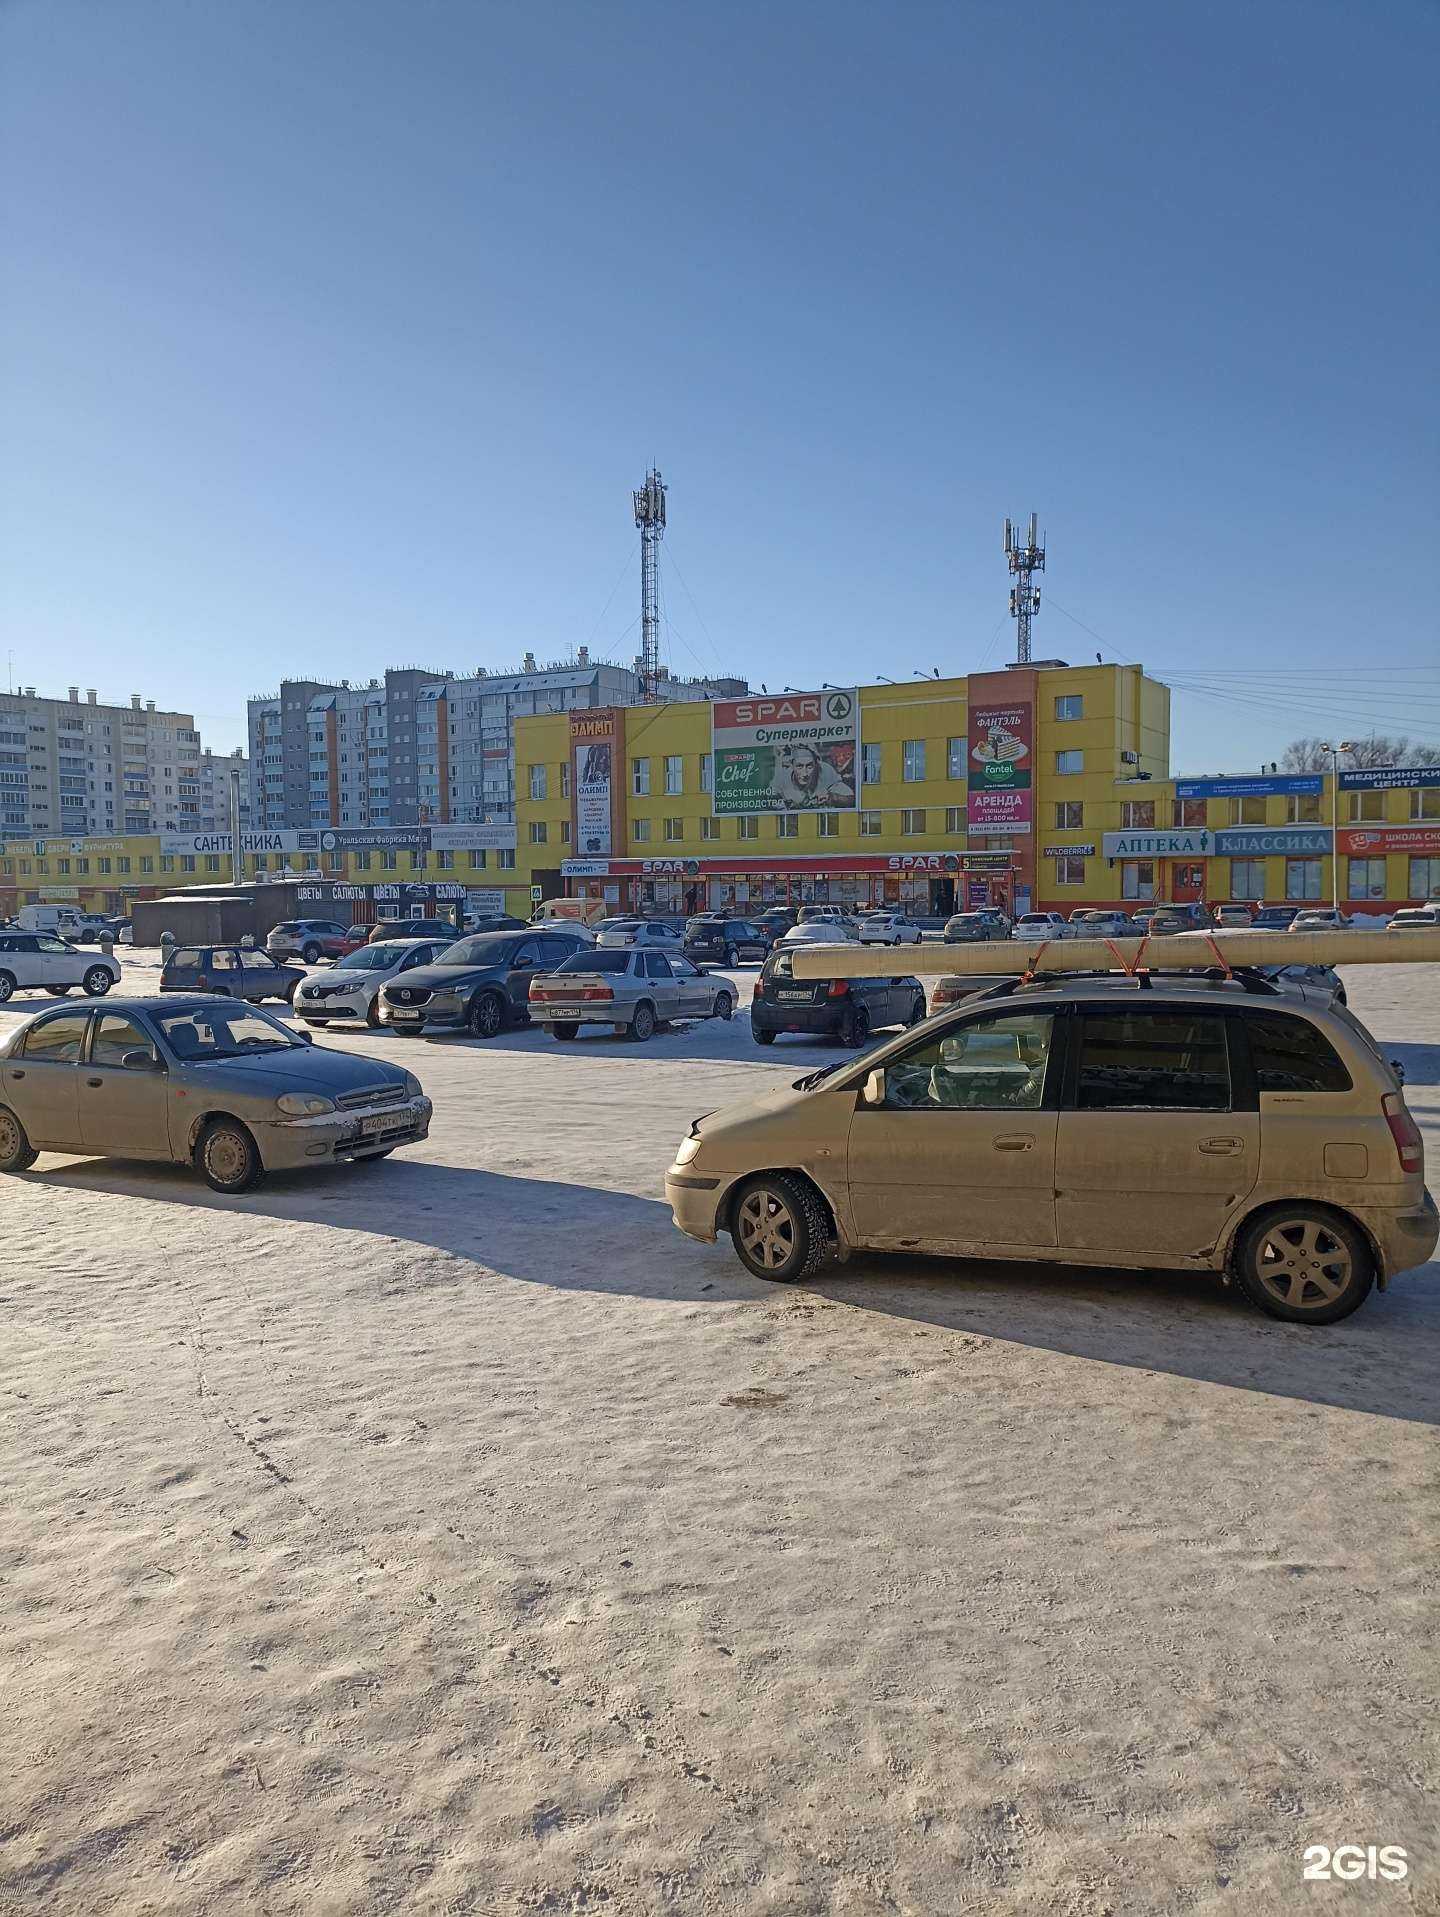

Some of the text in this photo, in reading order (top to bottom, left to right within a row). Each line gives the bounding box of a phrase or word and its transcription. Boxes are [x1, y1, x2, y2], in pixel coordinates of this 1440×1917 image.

[736, 699, 819, 723] SPAR
[977, 716, 1021, 728] ФАНТЭЛЬ
[756, 725, 853, 743] Супермаркет
[985, 764, 1014, 775] Fantel
[579, 785, 609, 794] ОЛИМП
[1373, 779, 1420, 789] ЦЕНТР
[715, 786, 777, 798] СОБСТВЕННОЕ
[716, 799, 785, 810] ПРОИЗВОДСТВО
[974, 795, 1023, 807] АРЕНДА
[338, 836, 375, 845] Уральская
[1221, 835, 1328, 851] КЛАССИКА
[1385, 832, 1422, 842] ШКОЛА
[1045, 847, 1093, 856] WILDBERRIES
[1116, 838, 1194, 853] АПТЕКА
[566, 865, 594, 873] ОЛИМП
[642, 861, 684, 873] SPAR
[889, 856, 940, 870] SPAR
[297, 886, 323, 900] ЦВЕТЫ
[332, 886, 366, 899] САЛЮТЫ
[373, 885, 400, 900] ЦВЕТЫ
[435, 884, 467, 899] САЛЮТЫ
